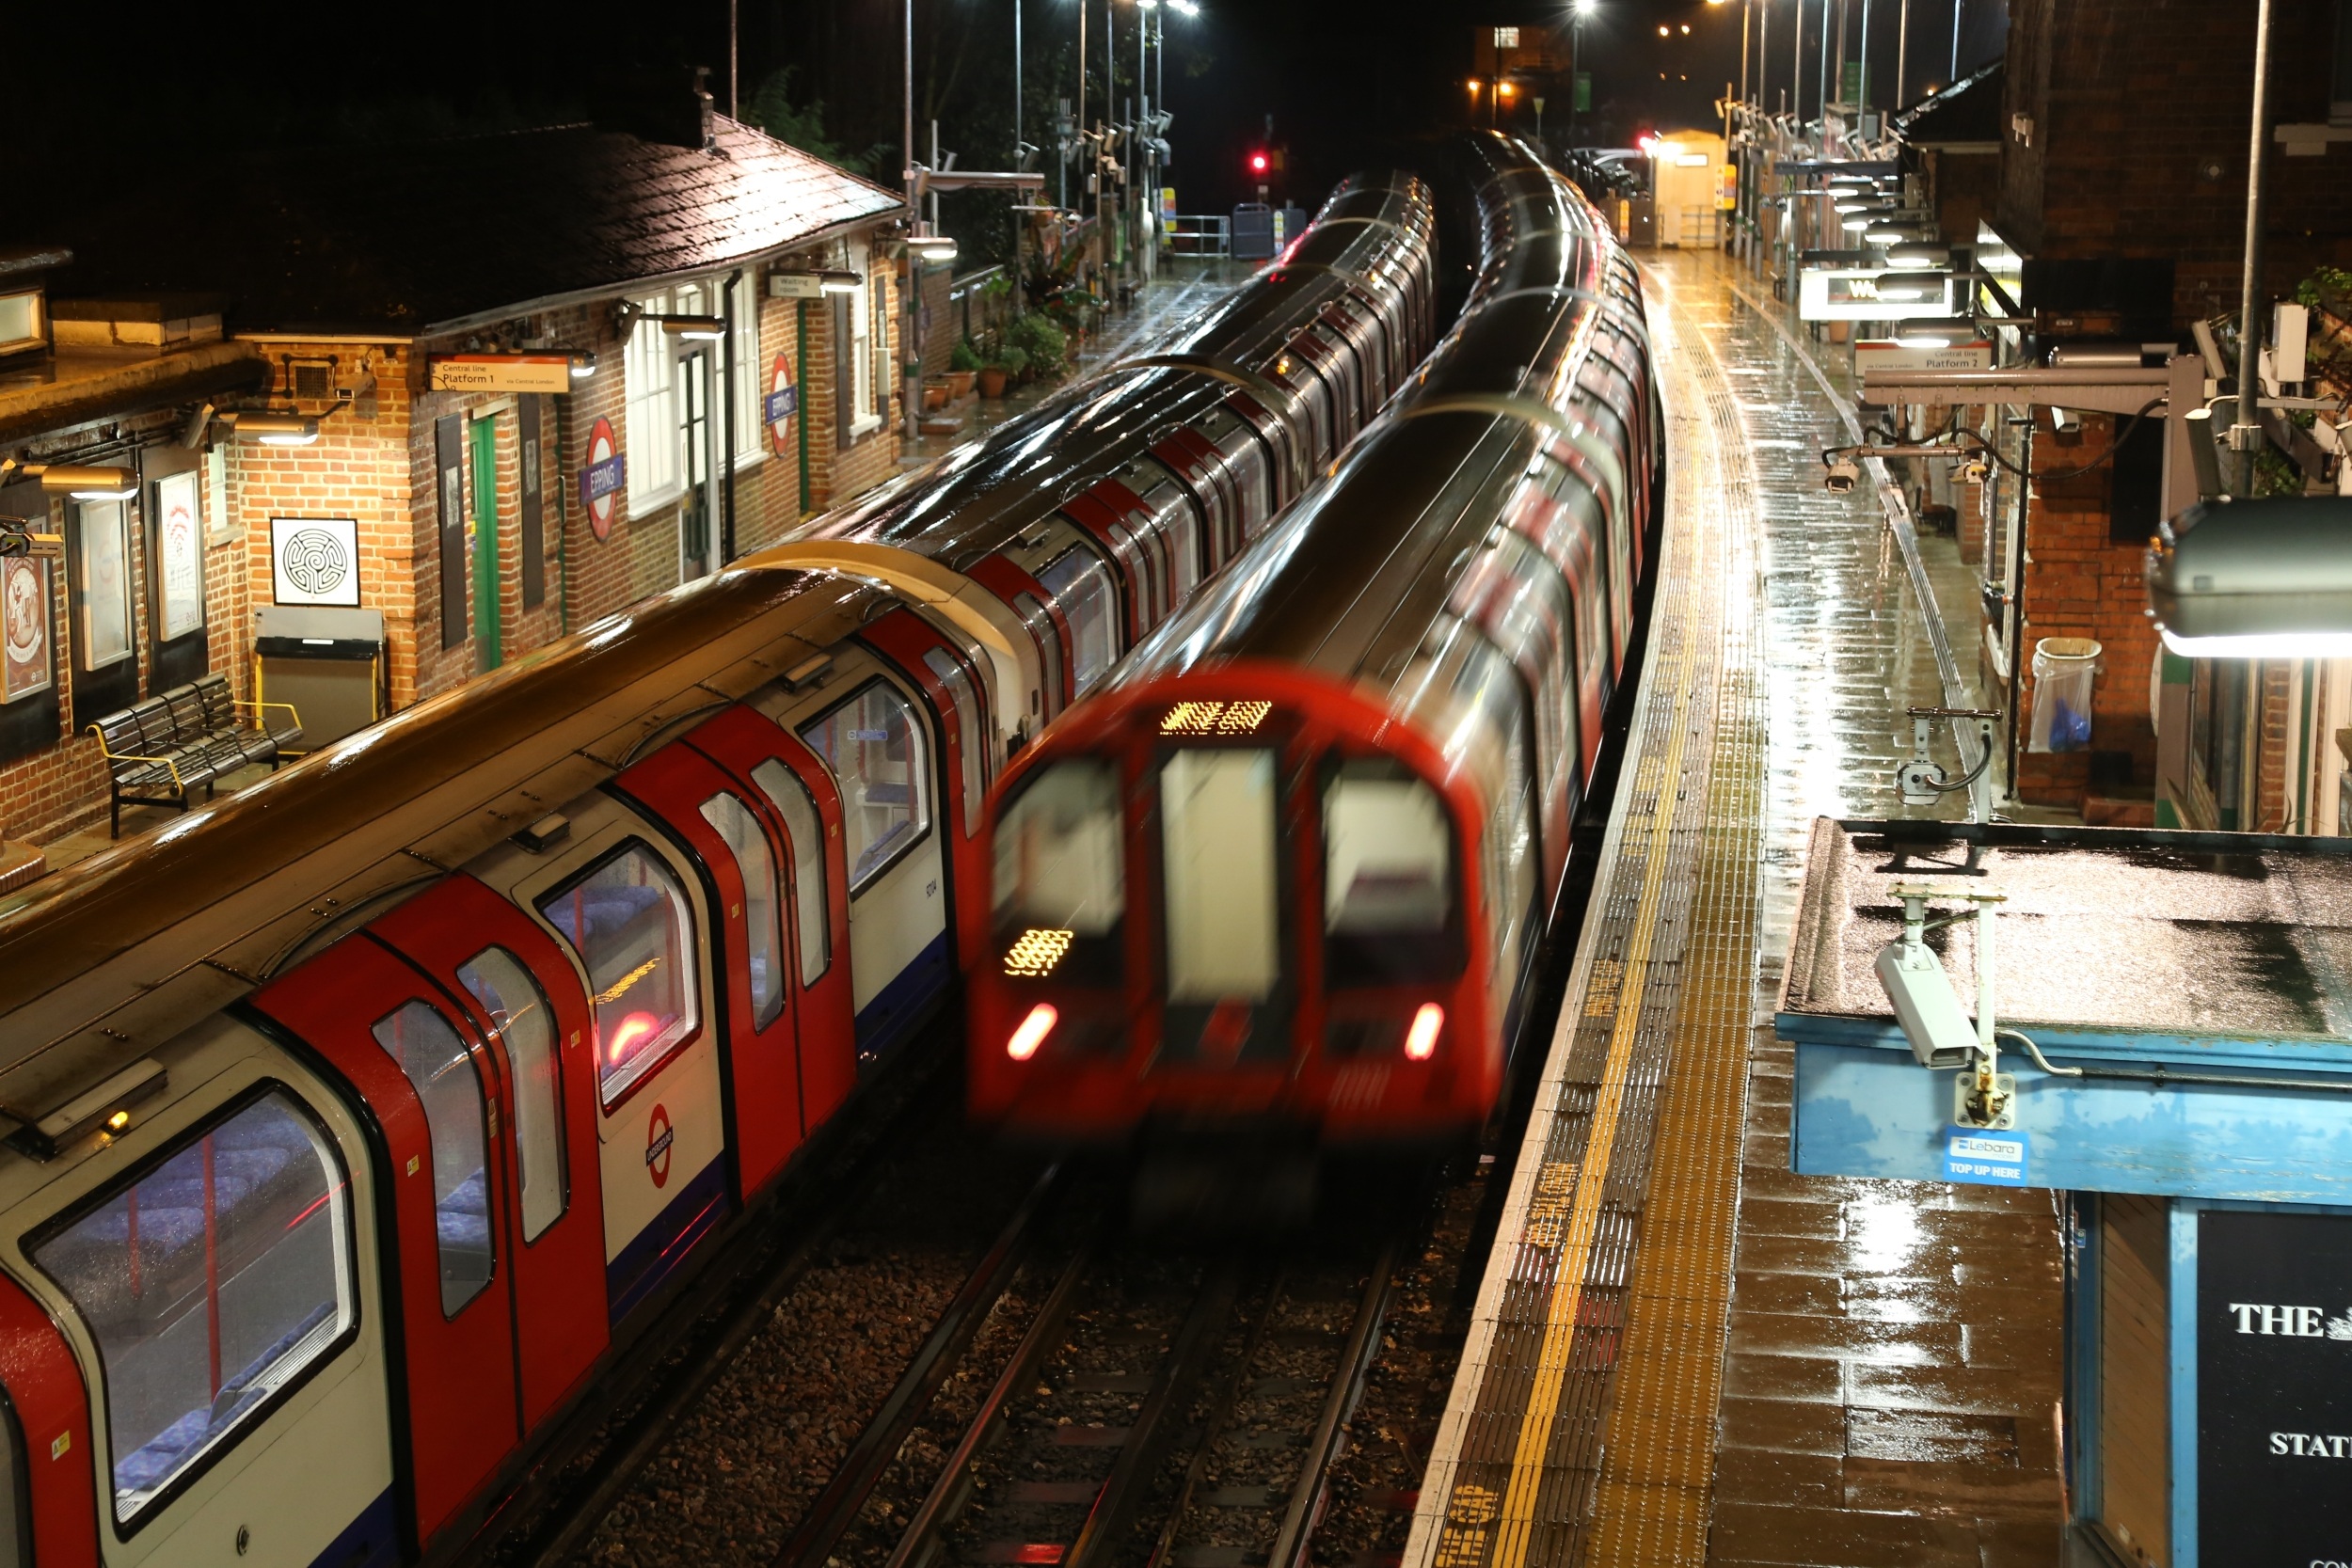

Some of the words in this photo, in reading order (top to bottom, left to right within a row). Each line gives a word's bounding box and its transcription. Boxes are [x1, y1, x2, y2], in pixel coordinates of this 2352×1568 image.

[779, 277, 809, 286] Waiting
[1926, 359, 1970, 368] Platform
[1973, 359, 1979, 368] 2
[443, 373, 487, 383] Platform
[490, 374, 494, 383] 1
[772, 392, 791, 416] EPPING
[590, 464, 615, 494] EPPING
[646, 1131, 673, 1162] UNDERGROUND
[1969, 1140, 2015, 1154] Lebara
[1538, 1162, 1579, 1195] MIND
[1948, 1162, 1973, 1174] TOP
[1974, 1164, 1991, 1176] UP
[1992, 1166, 2022, 1180] HERE
[1531, 1196, 1571, 1219] THE
[1525, 1223, 1563, 1247] GAP
[2228, 1303, 2324, 1337] THE
[1449, 1485, 1499, 1523] GAP
[1435, 1527, 1486, 1568] THE
